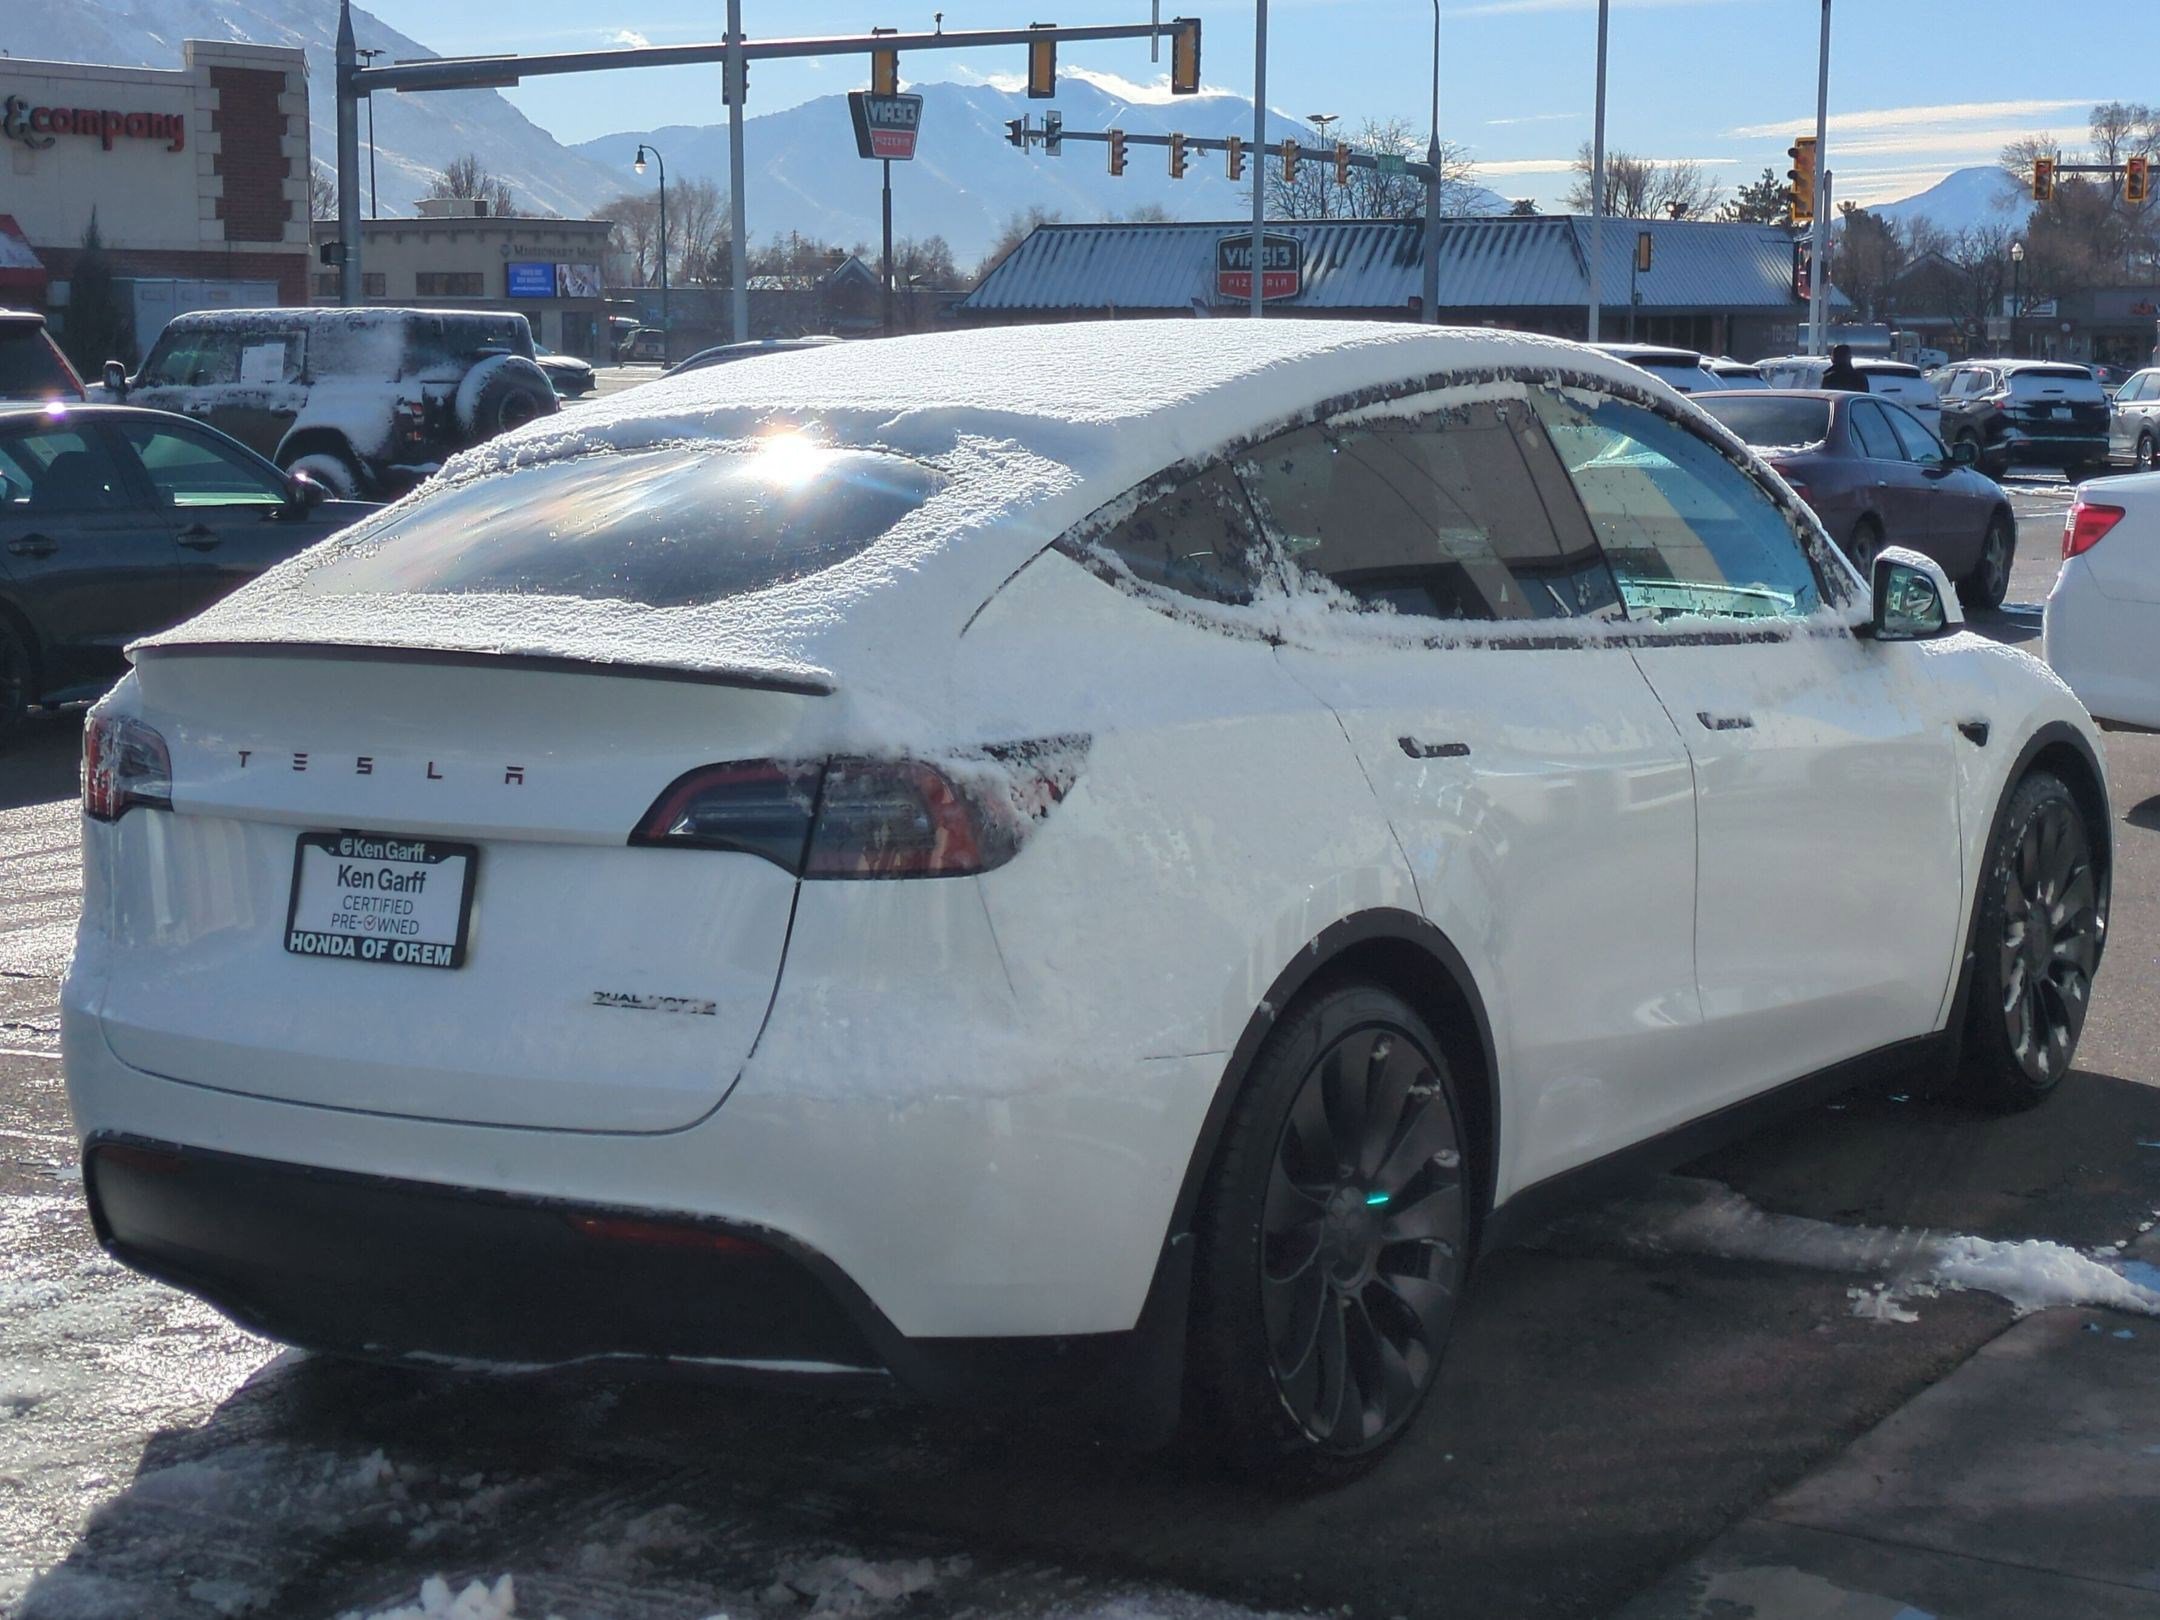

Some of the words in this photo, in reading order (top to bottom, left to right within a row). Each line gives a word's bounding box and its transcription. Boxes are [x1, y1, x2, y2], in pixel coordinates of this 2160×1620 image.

[238, 751, 525, 785] TESLA
[385, 841, 426, 862] Garff
[337, 864, 374, 889] Ken
[378, 868, 427, 894] Garff
[343, 895, 413, 915] CERTIFIED
[289, 932, 356, 957] HONDA
[362, 938, 389, 959] OF
[393, 942, 453, 966] OREM
